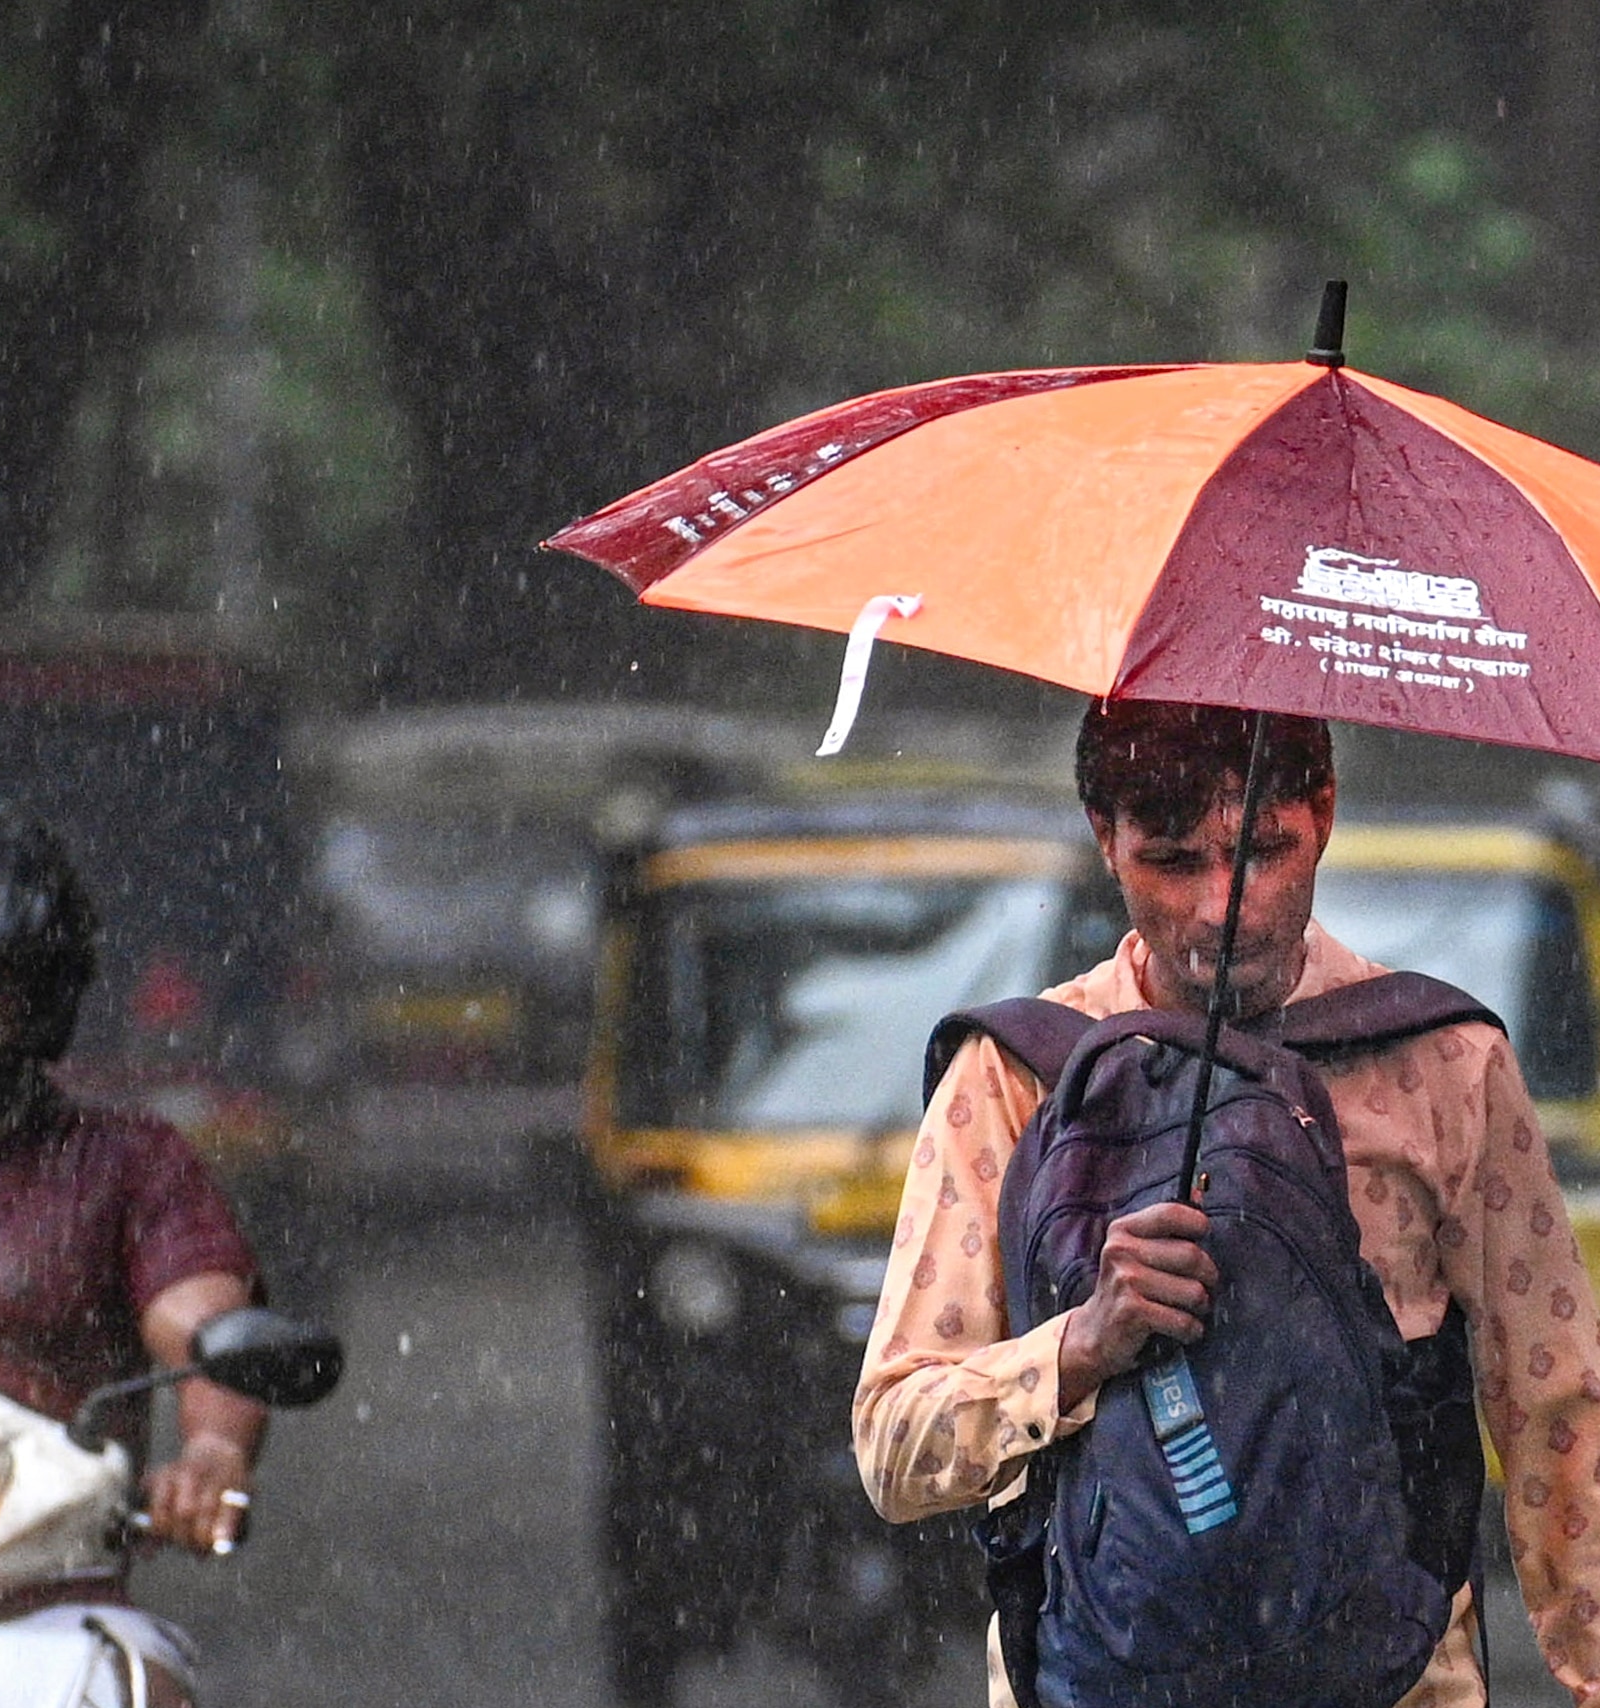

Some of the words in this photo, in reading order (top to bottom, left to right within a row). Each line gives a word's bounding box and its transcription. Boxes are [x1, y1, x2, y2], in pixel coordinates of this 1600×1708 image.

[1260, 595, 1348, 629] महाराष्ट्र
[1352, 613, 1470, 644] नवनिर्माण
[1474, 624, 1528, 650] सेना
[1378, 640, 1442, 670] शंकर
